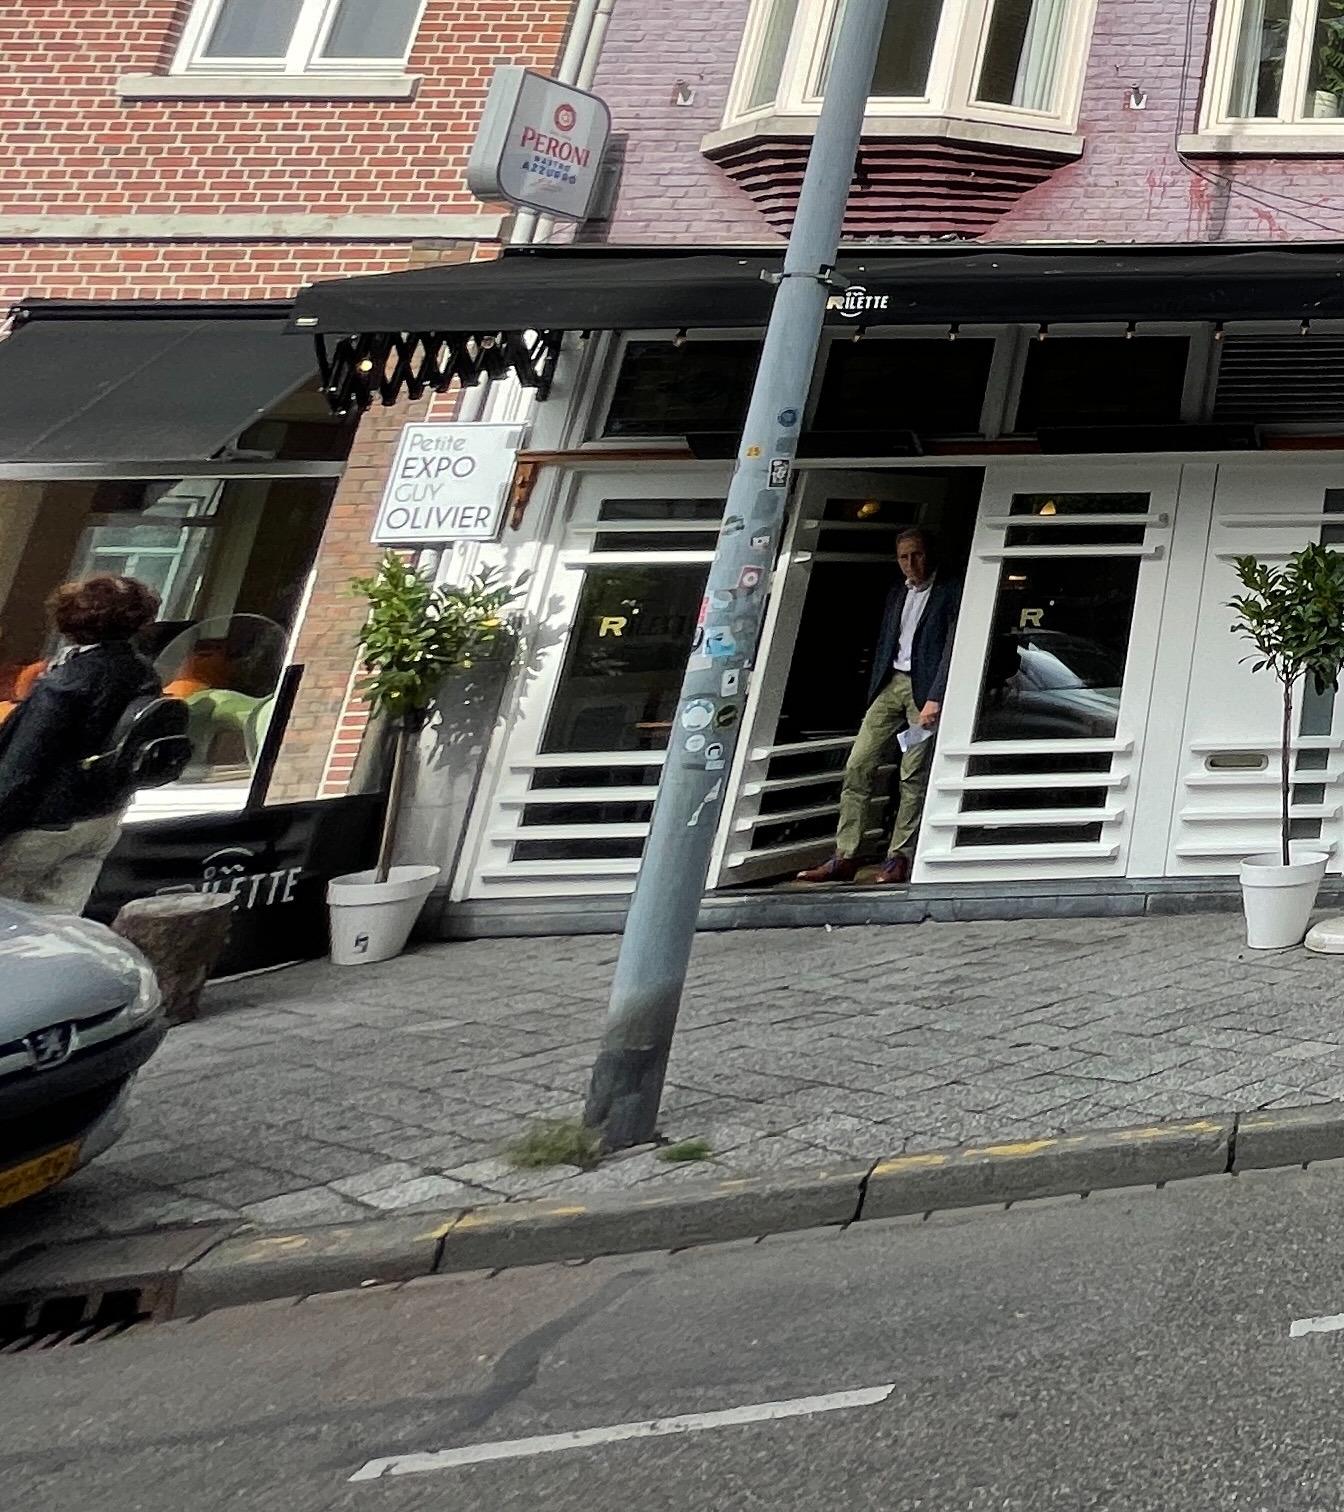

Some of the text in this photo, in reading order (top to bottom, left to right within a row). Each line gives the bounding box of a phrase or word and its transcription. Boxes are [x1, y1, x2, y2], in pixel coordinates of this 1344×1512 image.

[520, 126, 591, 168] PERONI
[826, 292, 889, 310] RILETTE
[409, 433, 467, 452] Petite
[401, 455, 476, 479] EXPO
[394, 482, 444, 503] GUY
[386, 506, 491, 530] OLIVIER
